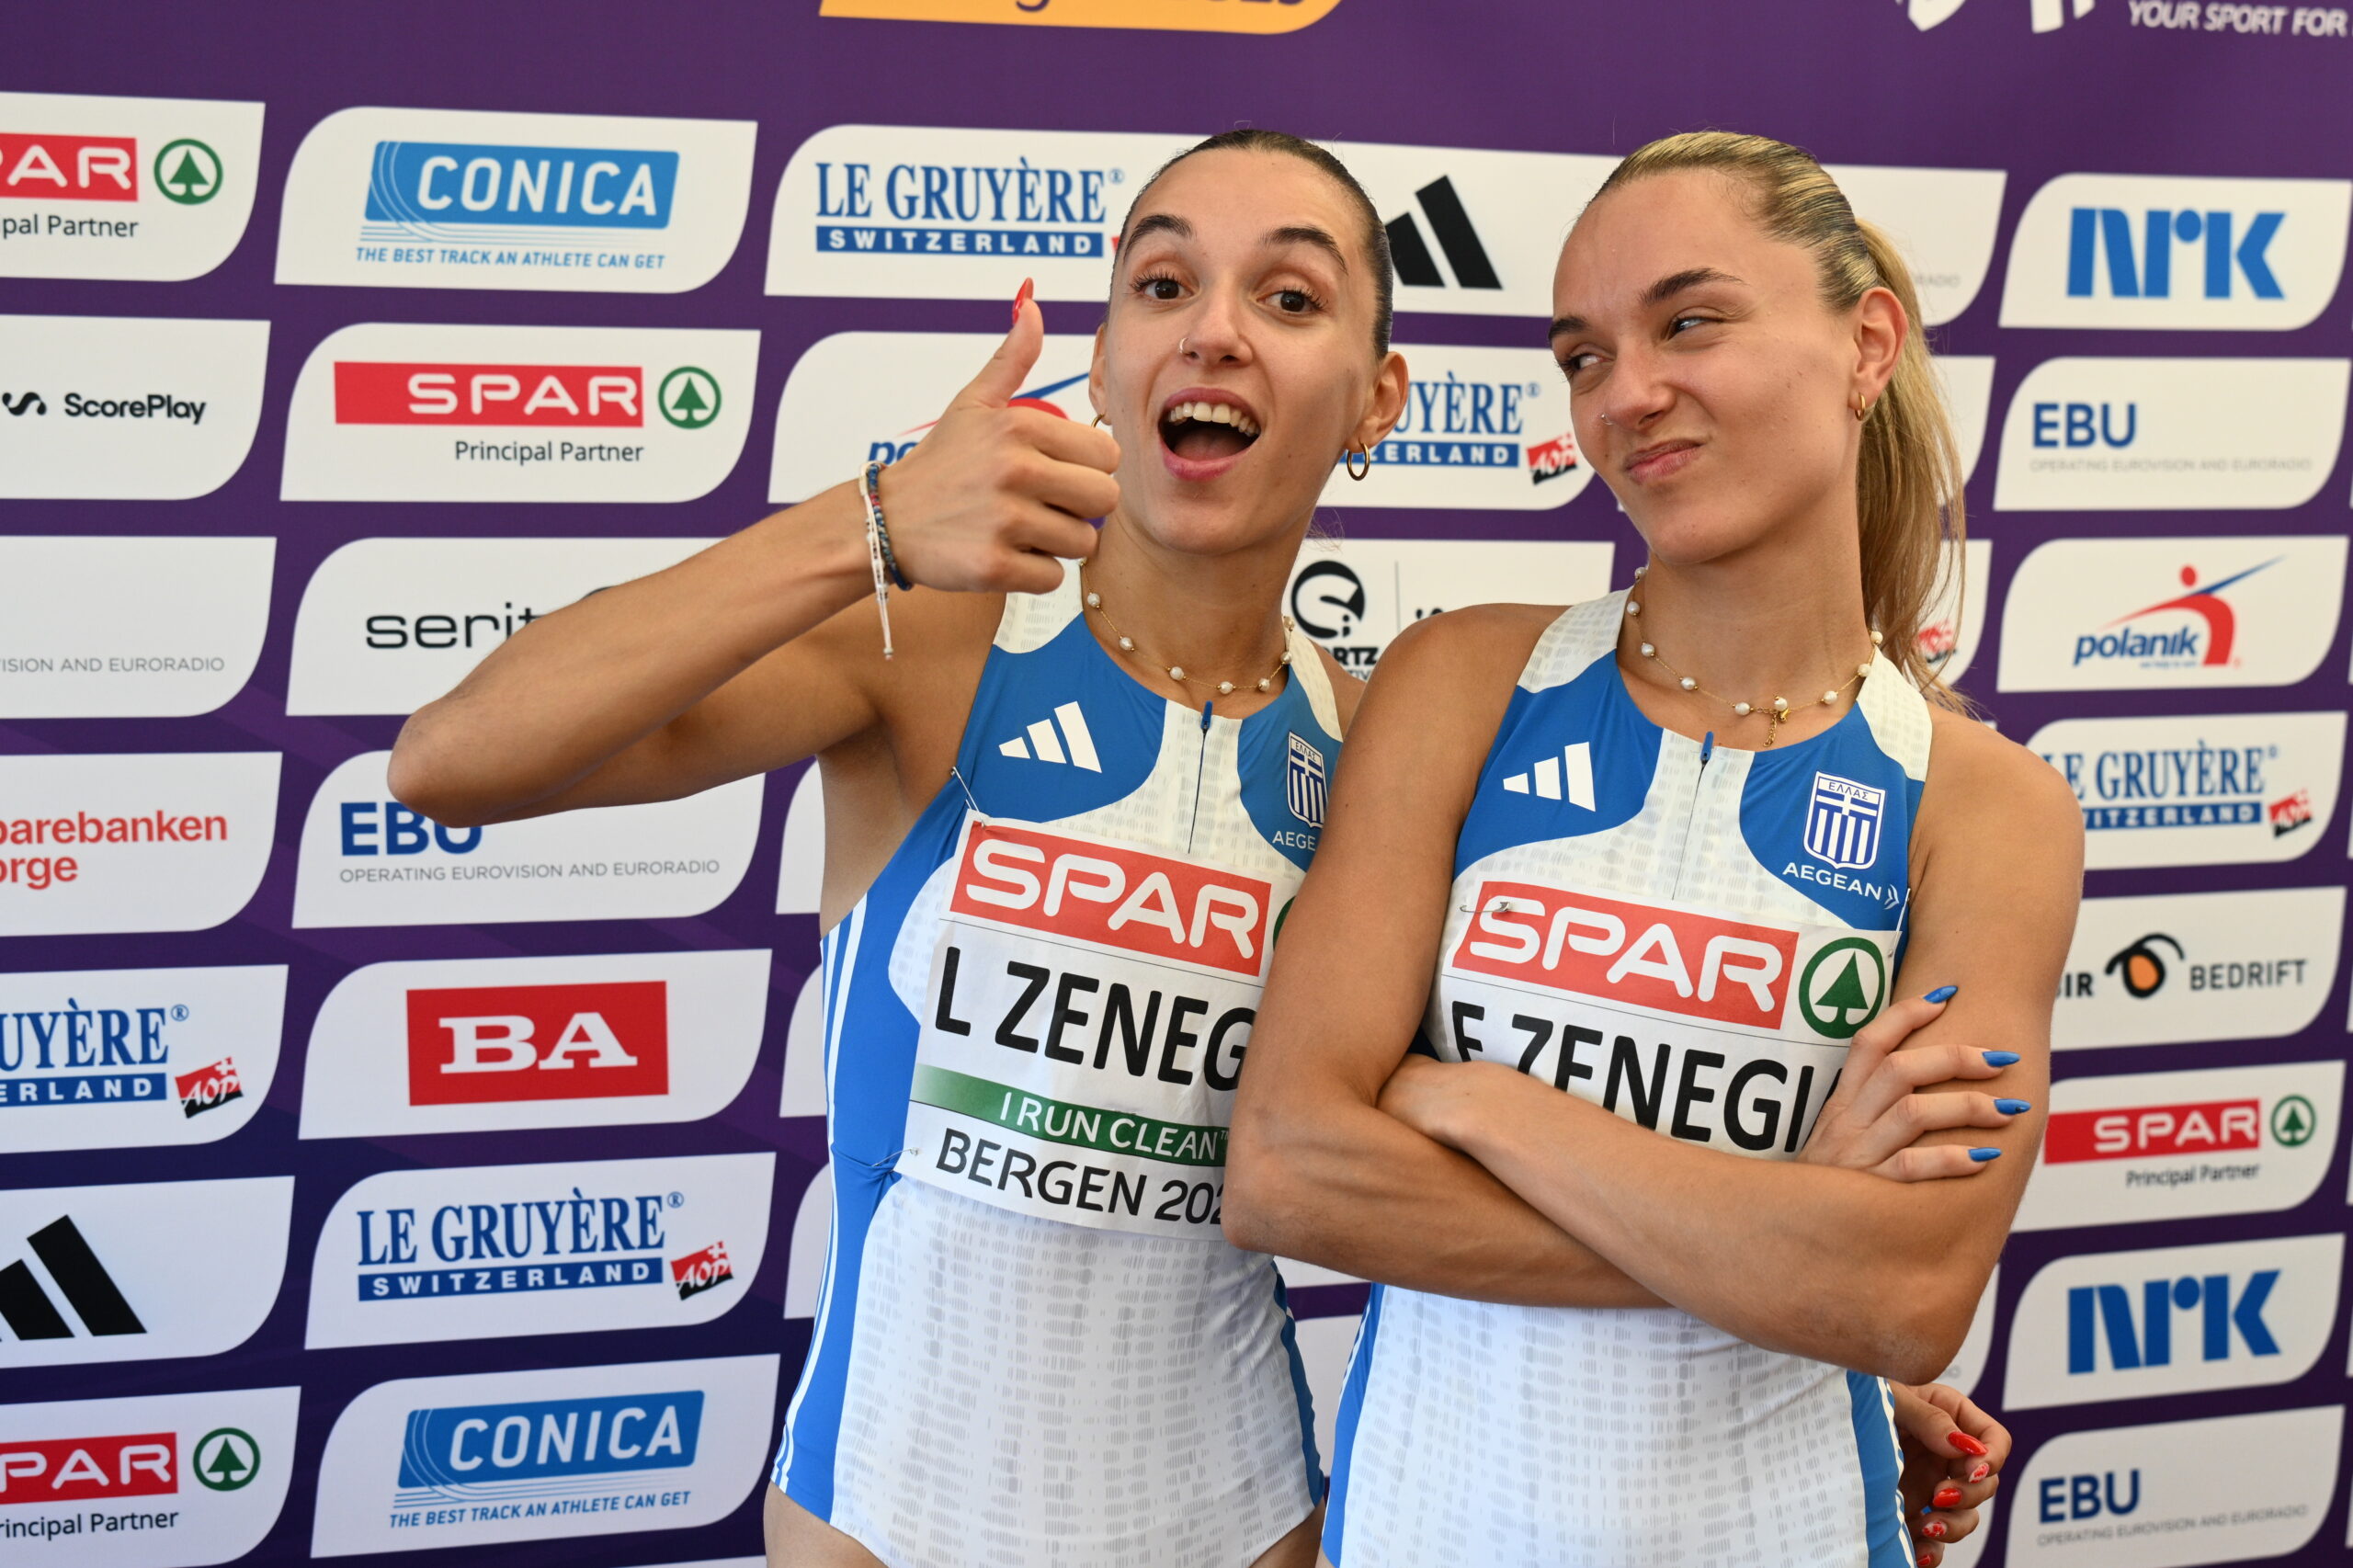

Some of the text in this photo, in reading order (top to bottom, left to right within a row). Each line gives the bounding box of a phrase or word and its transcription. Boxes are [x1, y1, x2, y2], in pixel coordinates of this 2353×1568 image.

[2129, 0, 2348, 38] YOUR SPORT FOR
[0, 144, 131, 189] AR
[416, 155, 657, 216] CONICA
[814, 163, 872, 218] LE
[48, 214, 139, 237] Partner
[829, 230, 1092, 255] SWITZERLAND
[356, 247, 665, 269] THE BEST TRACK AN ATHLETE CAN GET
[64, 392, 206, 425] ScorePlay
[407, 373, 638, 416] SPAR
[2032, 403, 2137, 449] EBU
[455, 441, 644, 466] Principal Partner
[61, 657, 102, 673] AND
[109, 657, 226, 673] EURORADIO
[340, 801, 483, 856] EBU
[340, 859, 720, 883] OPERATING EUROVISION AND EURORADIO
[1782, 862, 1882, 901] AEGEAN
[966, 838, 1260, 960] SPAR
[1469, 894, 1784, 1013] SPAR
[935, 946, 972, 1037] L
[2189, 960, 2306, 991] BEDRIFT
[438, 1012, 638, 1074] BA
[1000, 1092, 1012, 1120] I
[1017, 1096, 1101, 1142] RUN
[2093, 1106, 2256, 1153] SPAR
[936, 1128, 1148, 1216] BERGEN
[2126, 1164, 2260, 1190] Principal Partner
[358, 1209, 417, 1266] LE
[373, 1262, 651, 1297] SWITZERLAND
[449, 1405, 682, 1471] CONICA
[390, 1490, 691, 1528] THE BEST TRACK AN ATHLETE CAN GET
[2039, 1470, 2140, 1524] EBU
[91, 1511, 179, 1532] Partner
[2037, 1505, 2310, 1547] OPERATING EUROVISION AND EURORADIO
